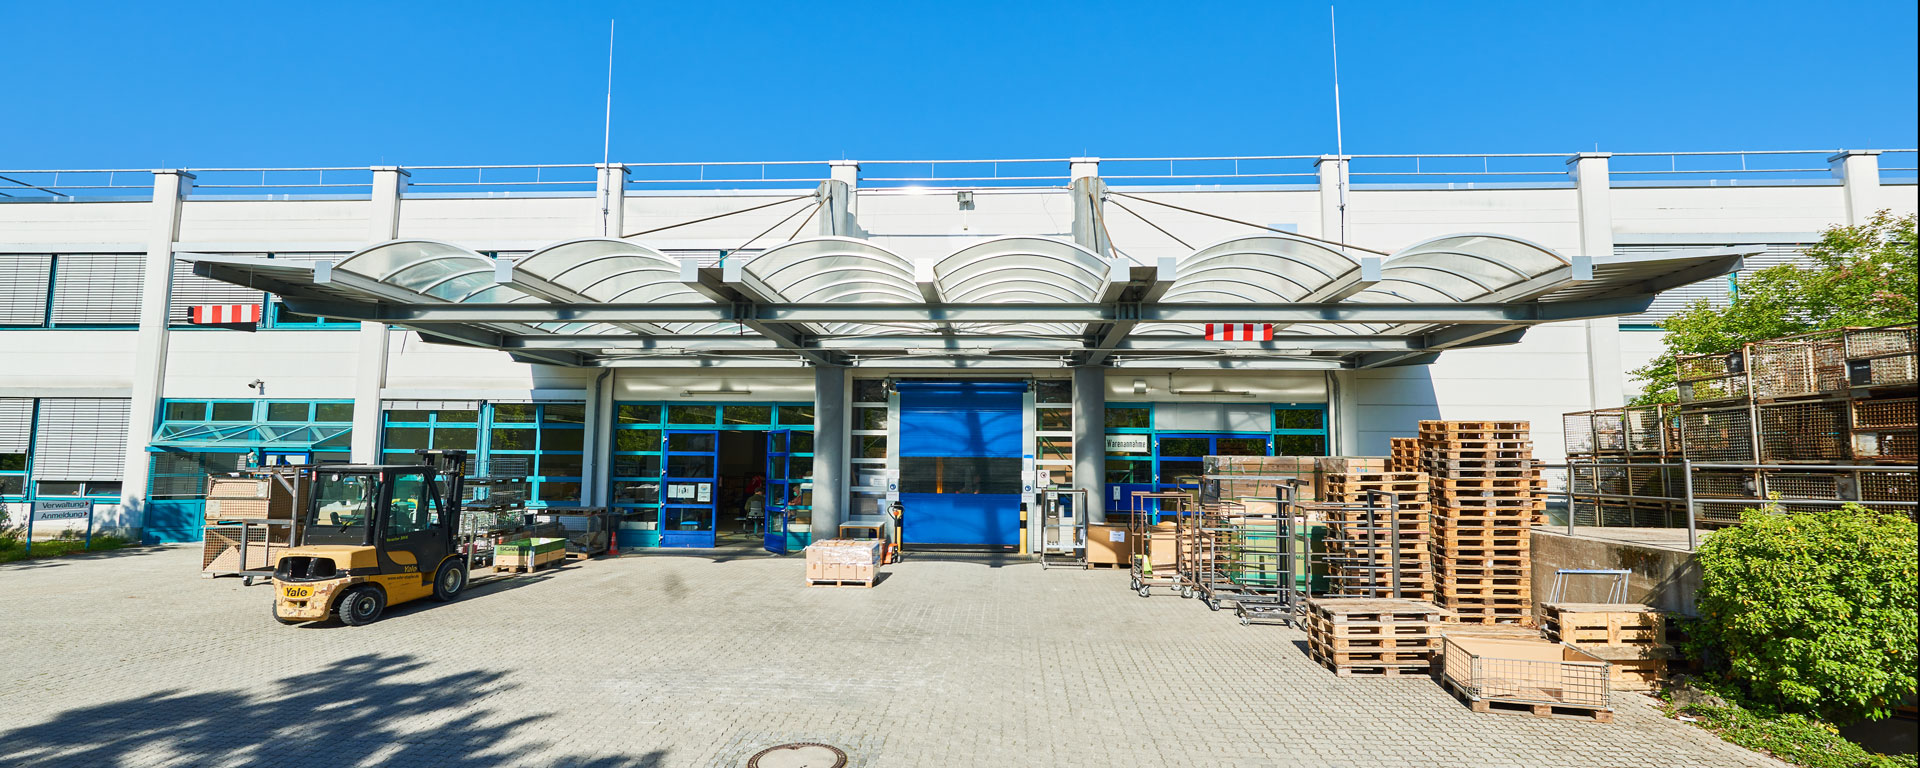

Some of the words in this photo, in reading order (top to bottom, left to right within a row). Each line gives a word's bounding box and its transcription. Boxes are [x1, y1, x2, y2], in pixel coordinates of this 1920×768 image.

[1106, 439, 1146, 448] Warenannahme
[42, 501, 85, 509] Verwaltung
[41, 511, 83, 519] Anmeldung
[404, 565, 418, 573] Yale
[286, 587, 308, 597] Yale
